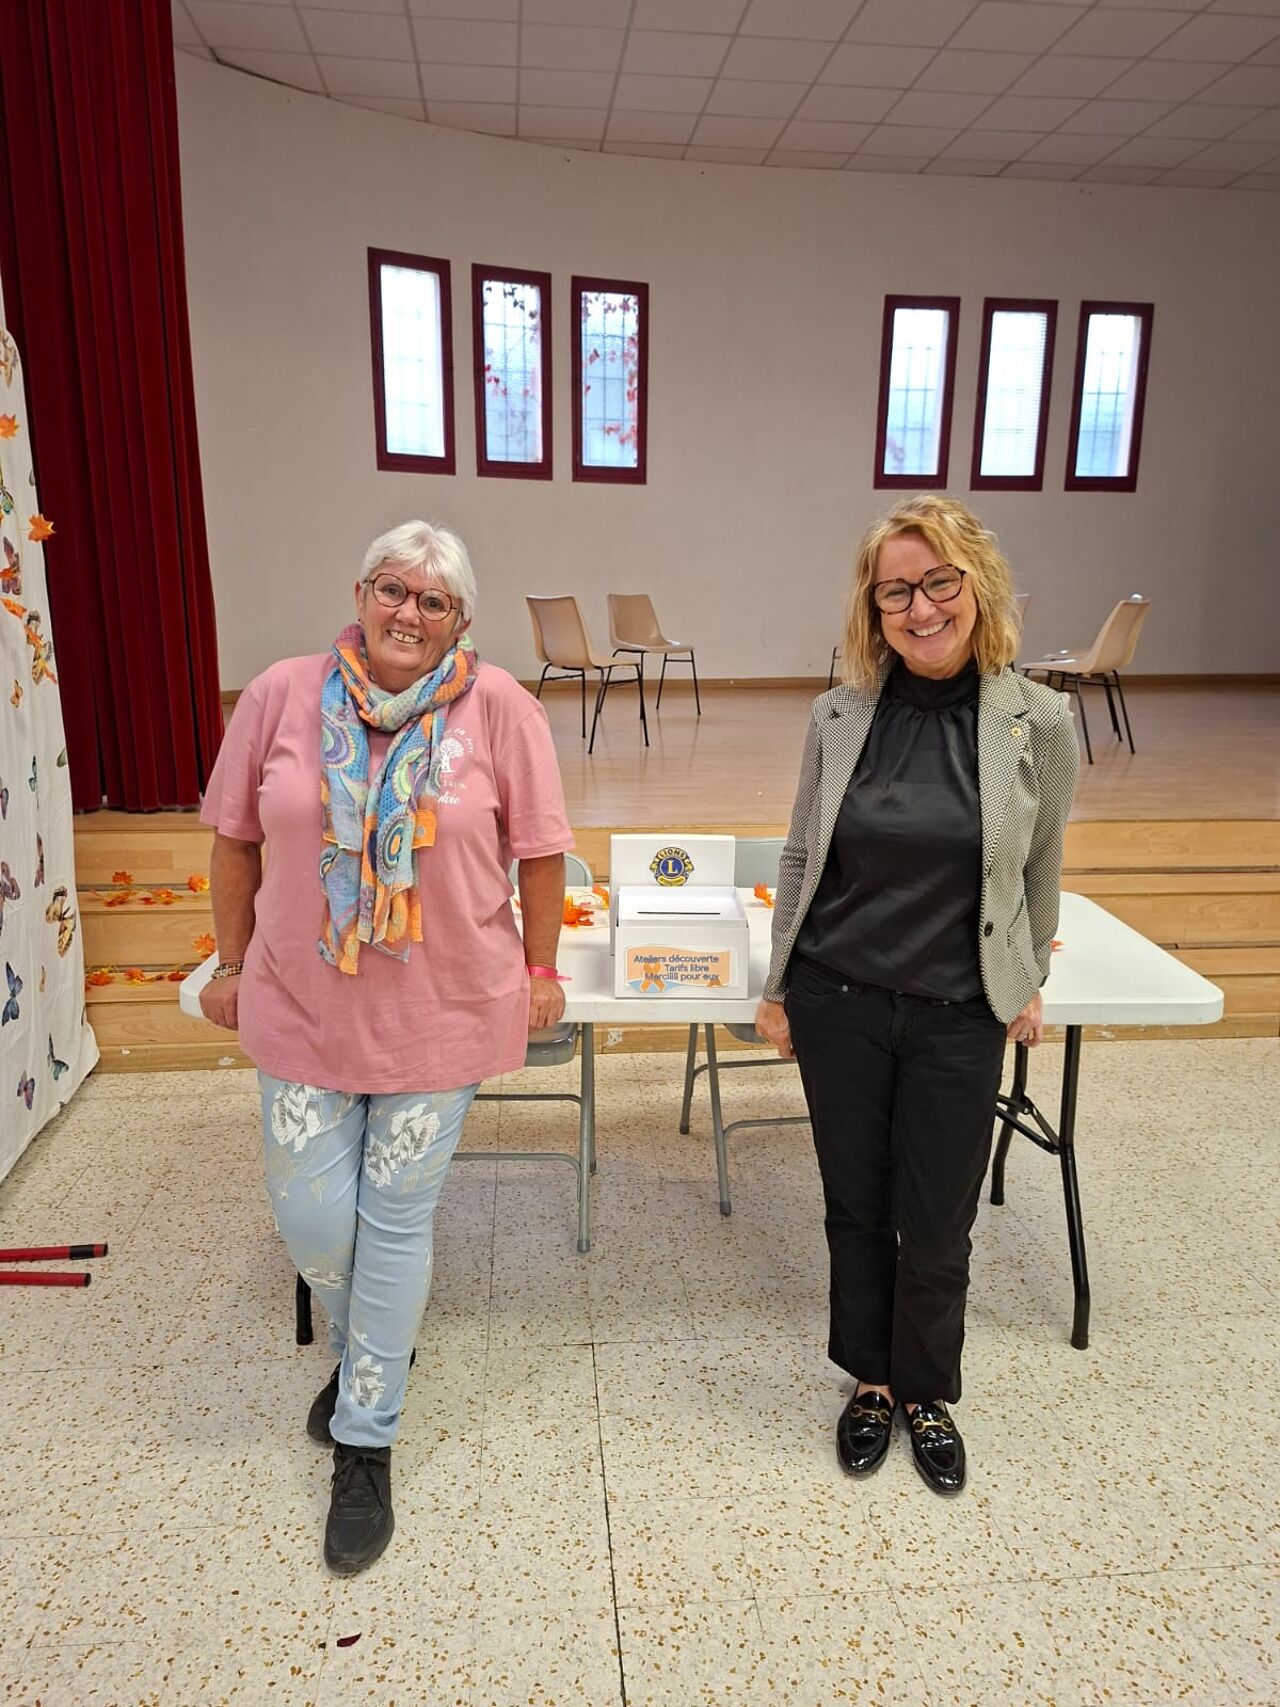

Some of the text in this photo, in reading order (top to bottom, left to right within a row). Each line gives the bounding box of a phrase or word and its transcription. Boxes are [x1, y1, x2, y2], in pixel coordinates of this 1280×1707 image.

[658, 848, 687, 858] LIONS
[667, 860, 679, 874] L
[634, 954, 719, 963] Ateliers découverte
[664, 963, 709, 972] Tarifs libre
[680, 973, 701, 982] pour
